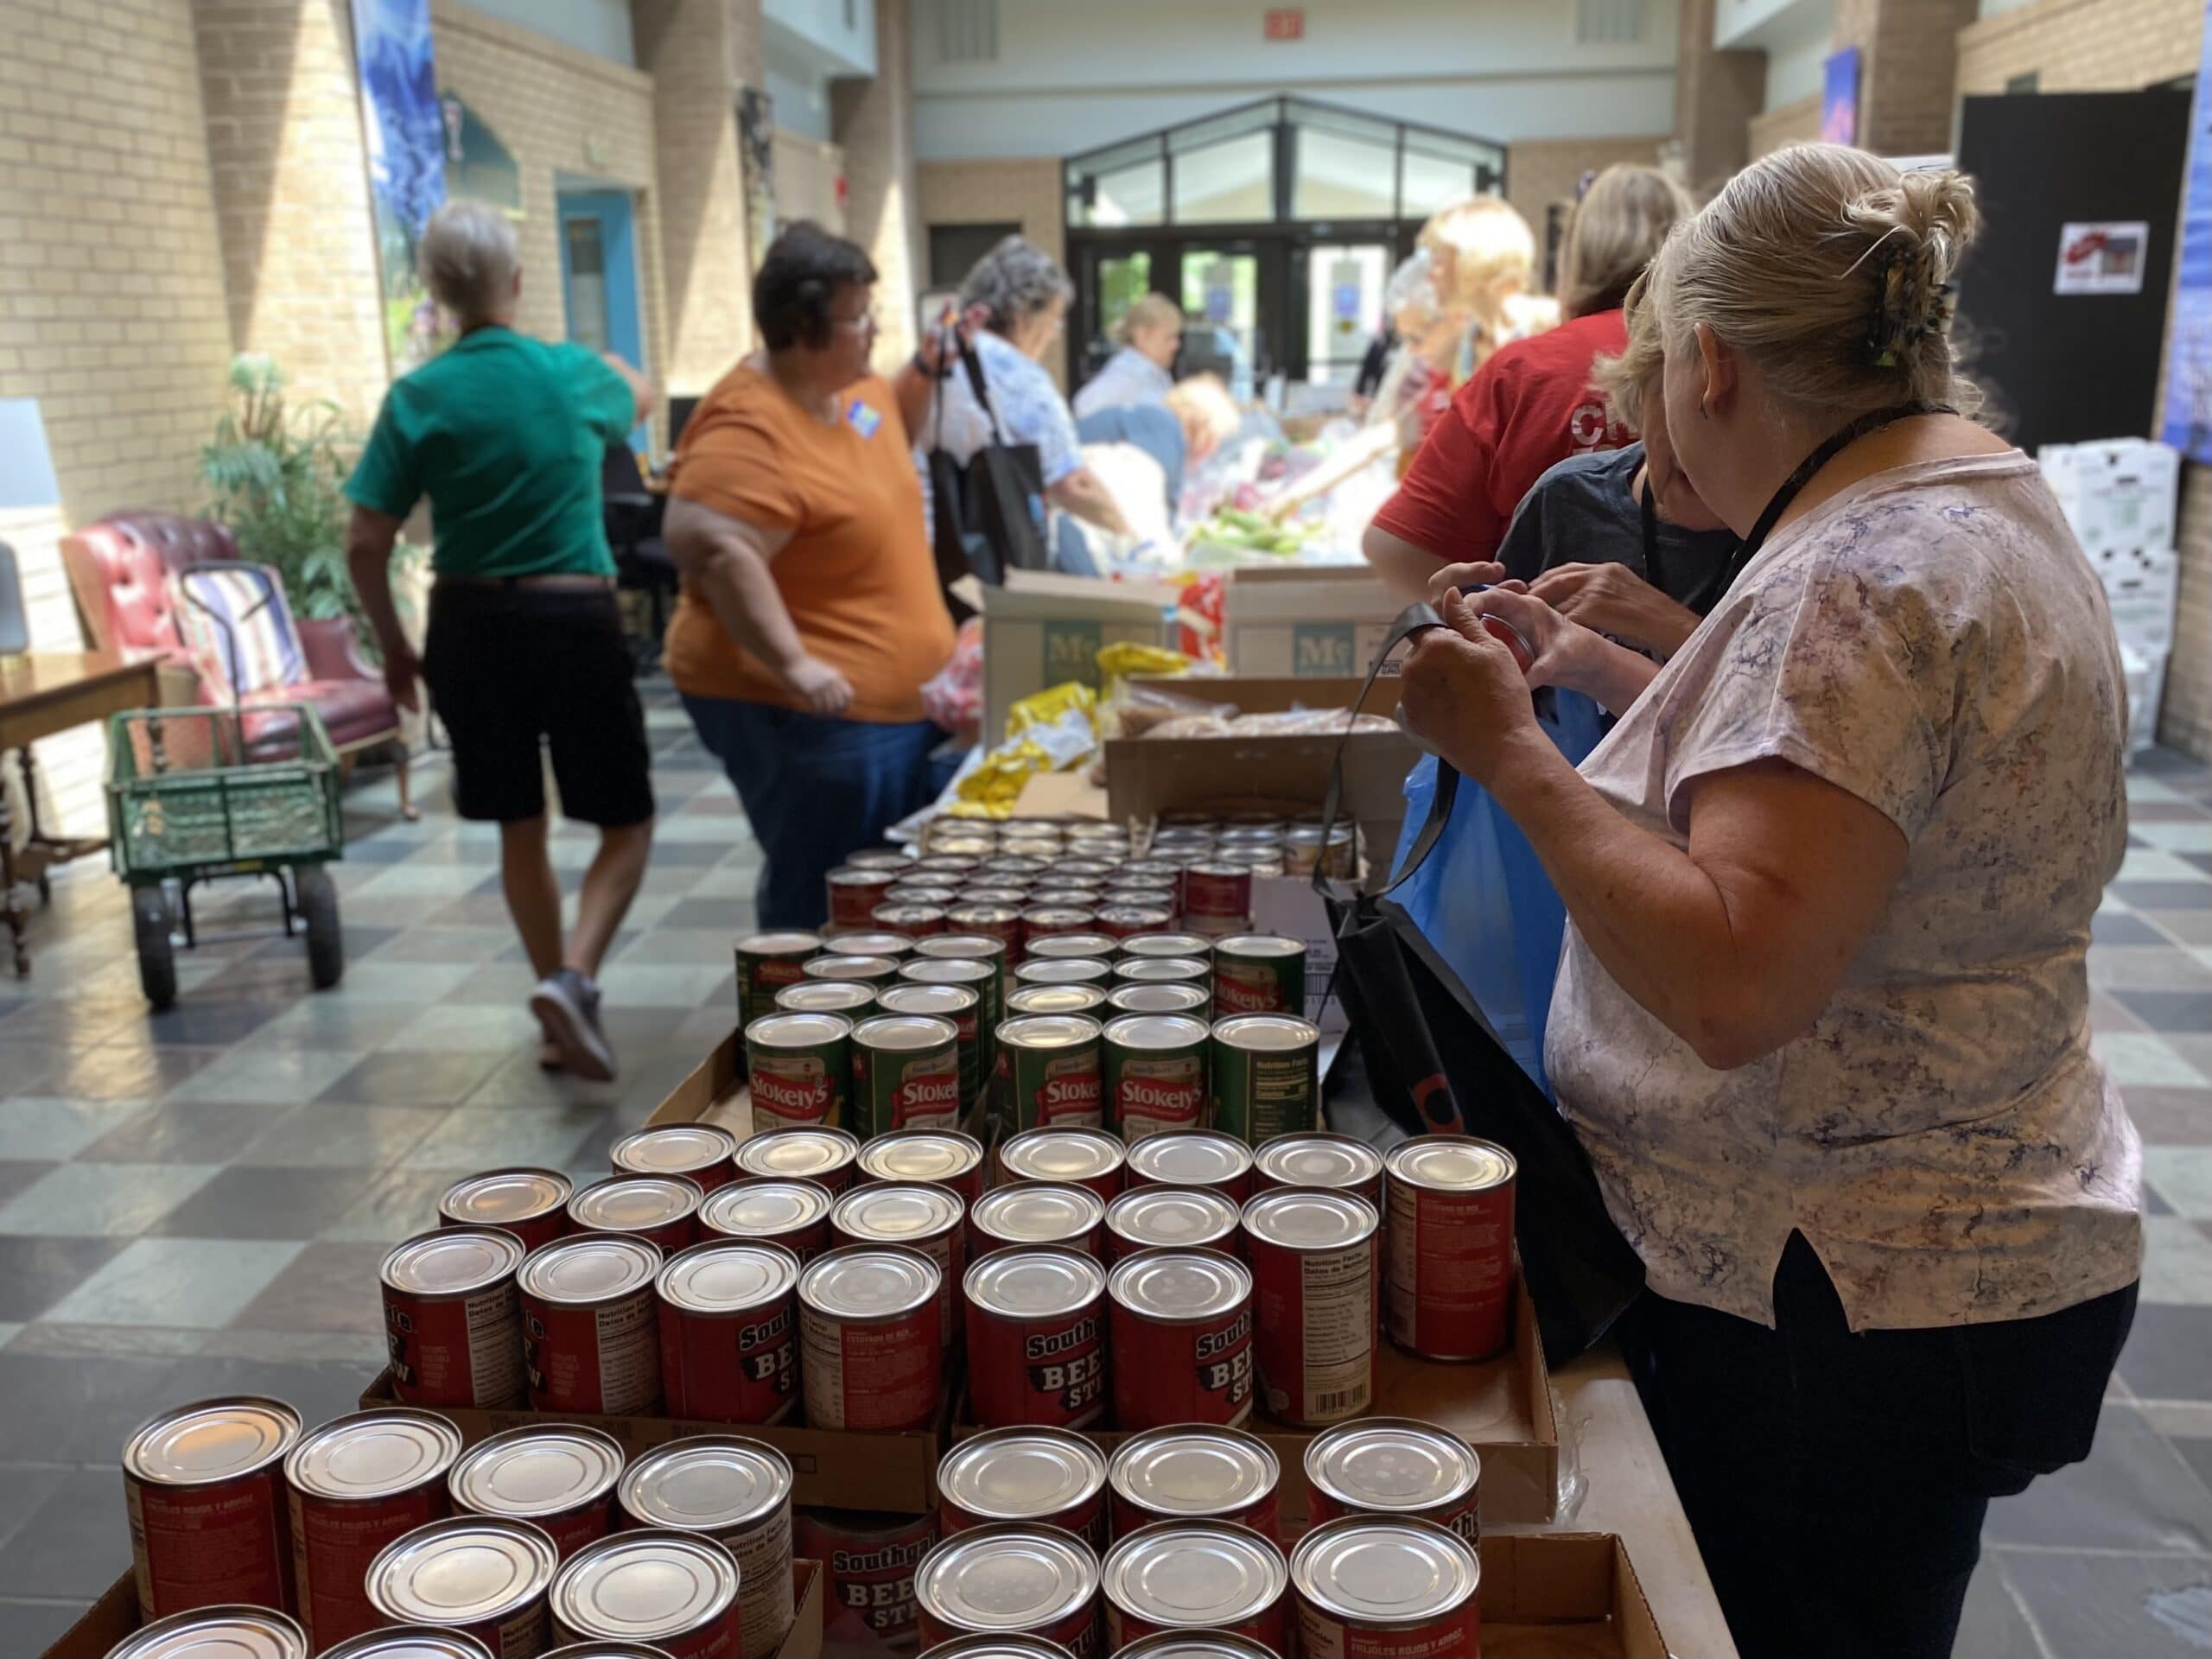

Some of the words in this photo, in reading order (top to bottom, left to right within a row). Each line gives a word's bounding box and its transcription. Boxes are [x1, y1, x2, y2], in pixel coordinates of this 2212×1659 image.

[1046, 1080, 1100, 1103] Stoke
[1042, 1349, 1101, 1390] BEE
[847, 1576, 915, 1606] BEE
[874, 1601, 919, 1628] STE
[1351, 1643, 1396, 1656] FRIJOLES
[1398, 1643, 1428, 1656] ROJOS
[1430, 1641, 1437, 1649] Y
[1437, 1629, 1463, 1647] ARROZ
